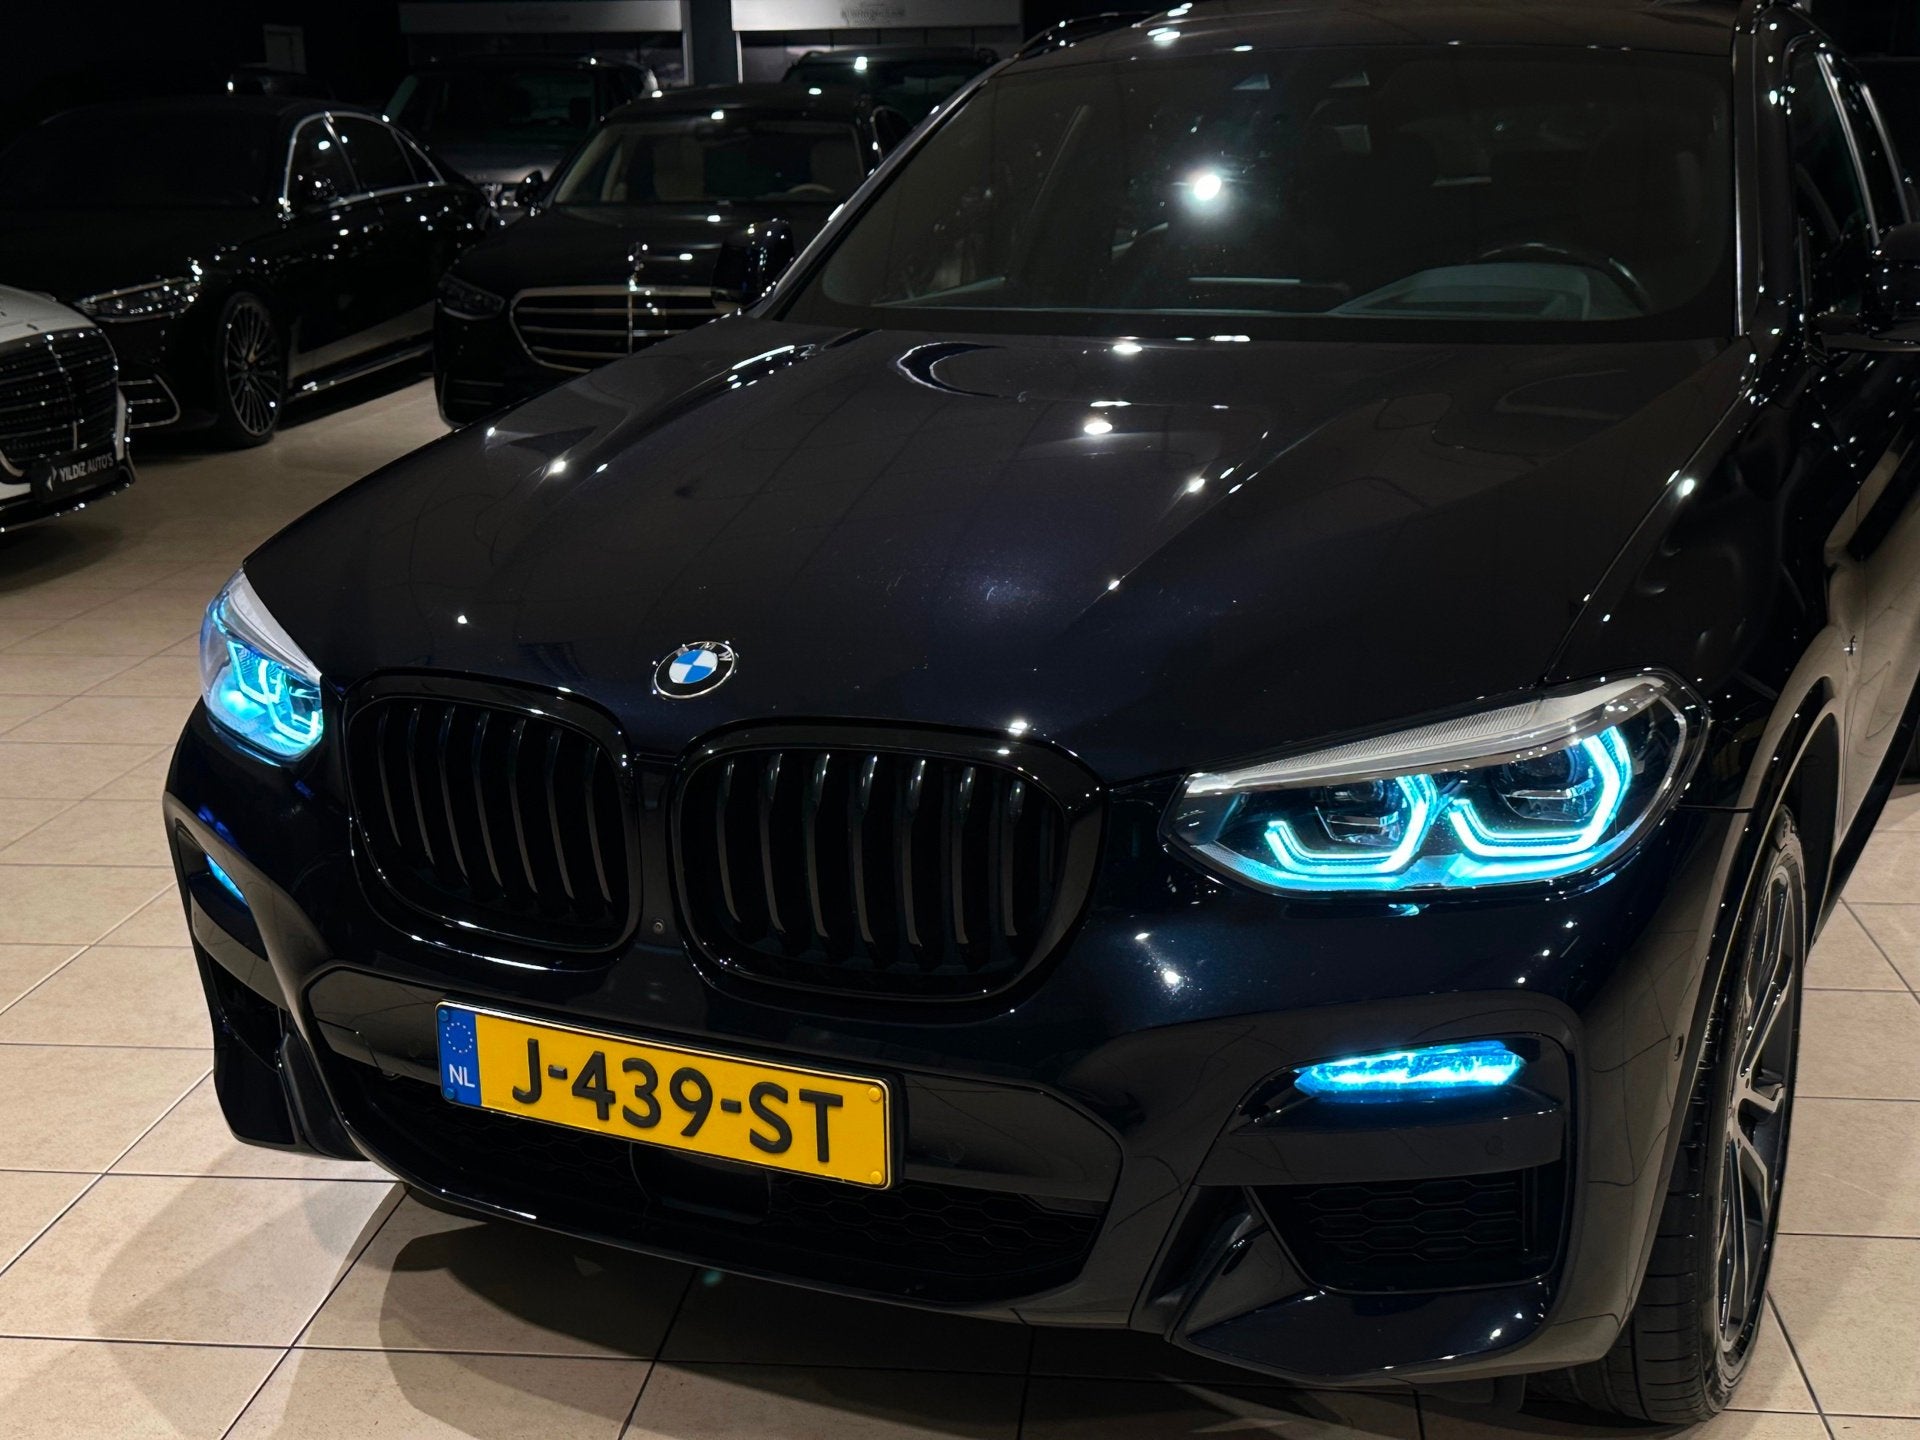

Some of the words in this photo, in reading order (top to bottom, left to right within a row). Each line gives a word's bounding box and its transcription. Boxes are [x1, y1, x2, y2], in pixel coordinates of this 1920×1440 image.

[59, 461, 87, 482] YILDIZ
[449, 1063, 475, 1088] NL
[512, 1038, 843, 1163] J-439-ST
